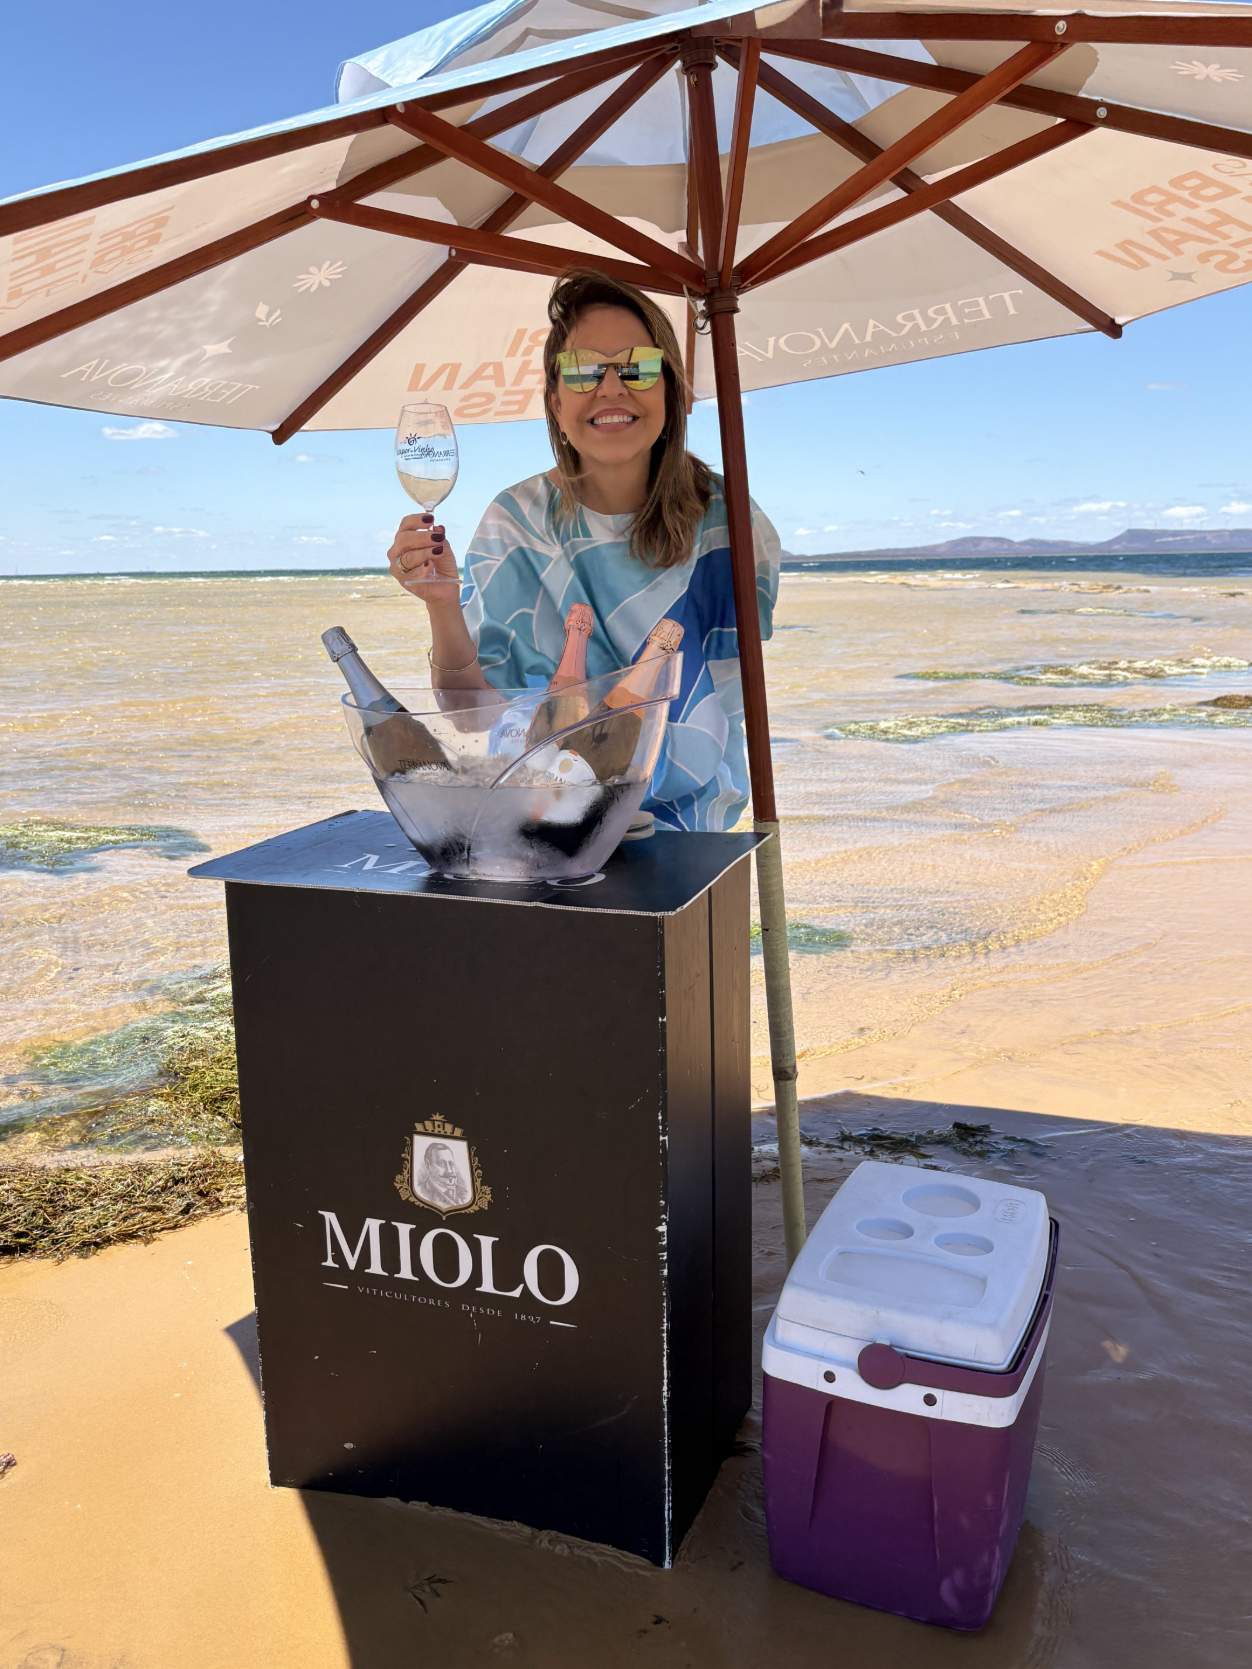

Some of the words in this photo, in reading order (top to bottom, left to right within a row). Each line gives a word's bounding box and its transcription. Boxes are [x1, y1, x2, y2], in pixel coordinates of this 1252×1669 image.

[317, 1210, 580, 1306] MIOLO
[357, 1285, 450, 1308] VITICULTORES
[461, 1303, 503, 1317] DESDE
[514, 1312, 541, 1324] 1897
